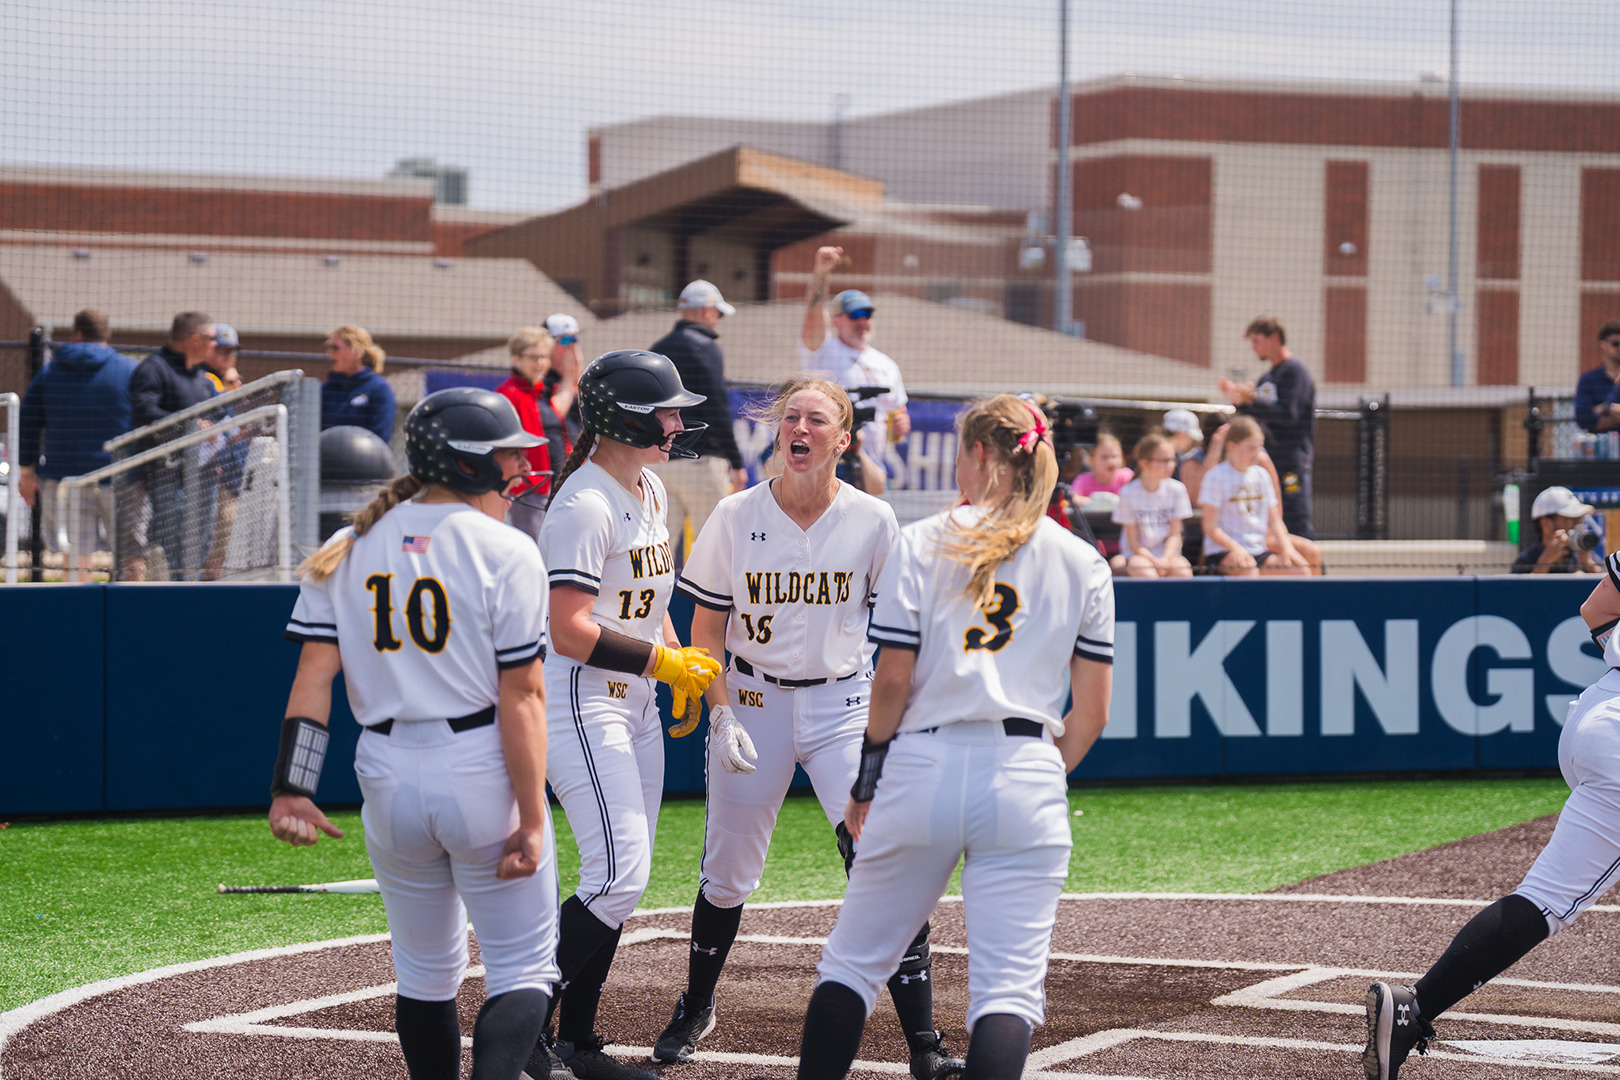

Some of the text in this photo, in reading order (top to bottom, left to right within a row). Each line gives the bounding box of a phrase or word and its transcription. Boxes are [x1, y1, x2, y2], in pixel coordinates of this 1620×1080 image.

[629, 538, 675, 579] WILD
[618, 588, 656, 621] 13
[745, 571, 854, 605] WILDCATS
[365, 573, 453, 654] 10
[963, 582, 1022, 654] 3
[607, 680, 629, 700] WSC
[1059, 615, 1609, 740] IKING
[738, 689, 764, 708] WSC
